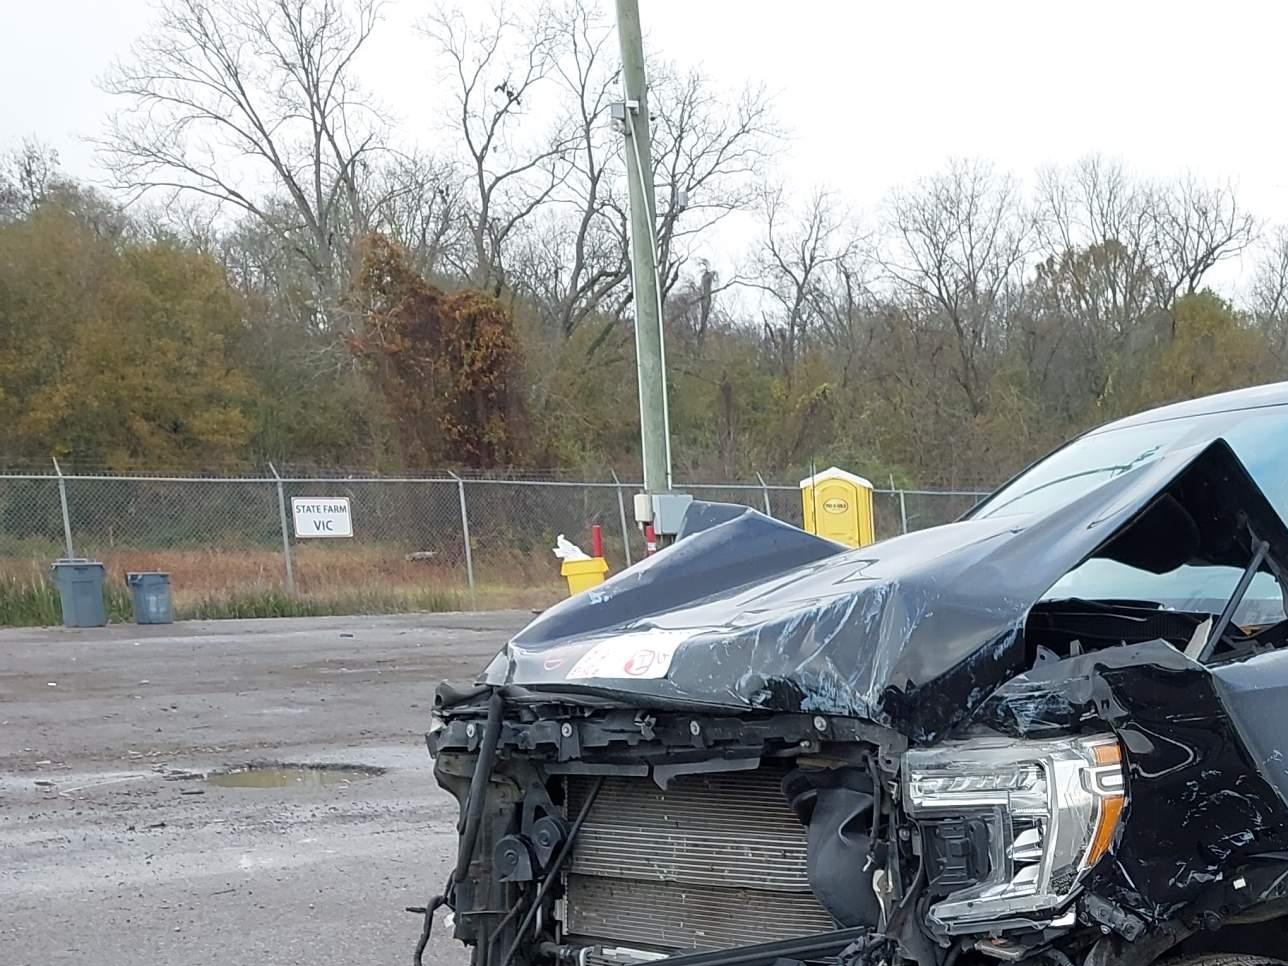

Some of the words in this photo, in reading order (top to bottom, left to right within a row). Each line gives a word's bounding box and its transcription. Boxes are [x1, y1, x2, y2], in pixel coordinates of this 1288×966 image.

[295, 504, 322, 514] STATE
[323, 504, 347, 514] FARM
[313, 519, 334, 531] VIC
